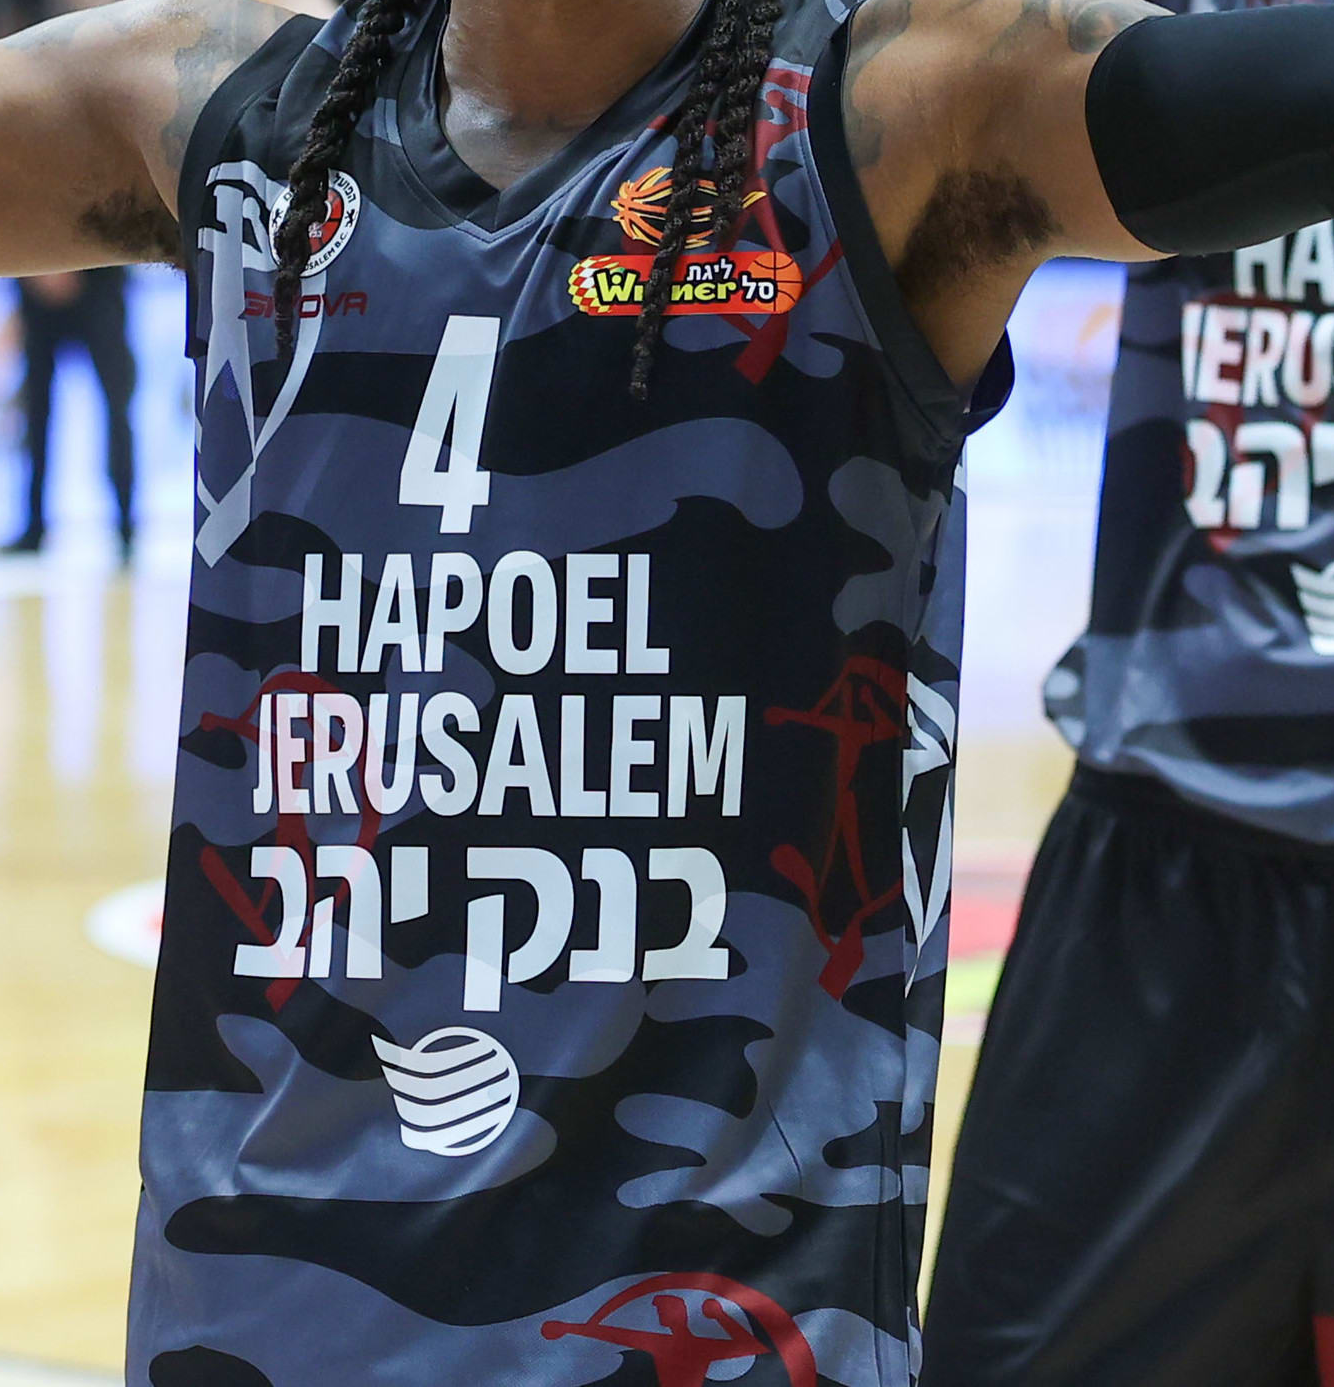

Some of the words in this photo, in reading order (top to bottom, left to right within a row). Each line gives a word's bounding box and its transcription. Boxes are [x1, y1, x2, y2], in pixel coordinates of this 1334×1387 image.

[244, 290, 368, 318] GIOVA
[595, 271, 737, 302] Winer
[686, 258, 735, 281] ליגת
[741, 274, 775, 300] סל
[398, 315, 501, 534] 4
[300, 550, 670, 676] HAPOEL
[252, 692, 748, 818] JERUSALEM
[232, 845, 430, 980] יהב
[463, 846, 730, 1012] בנק
